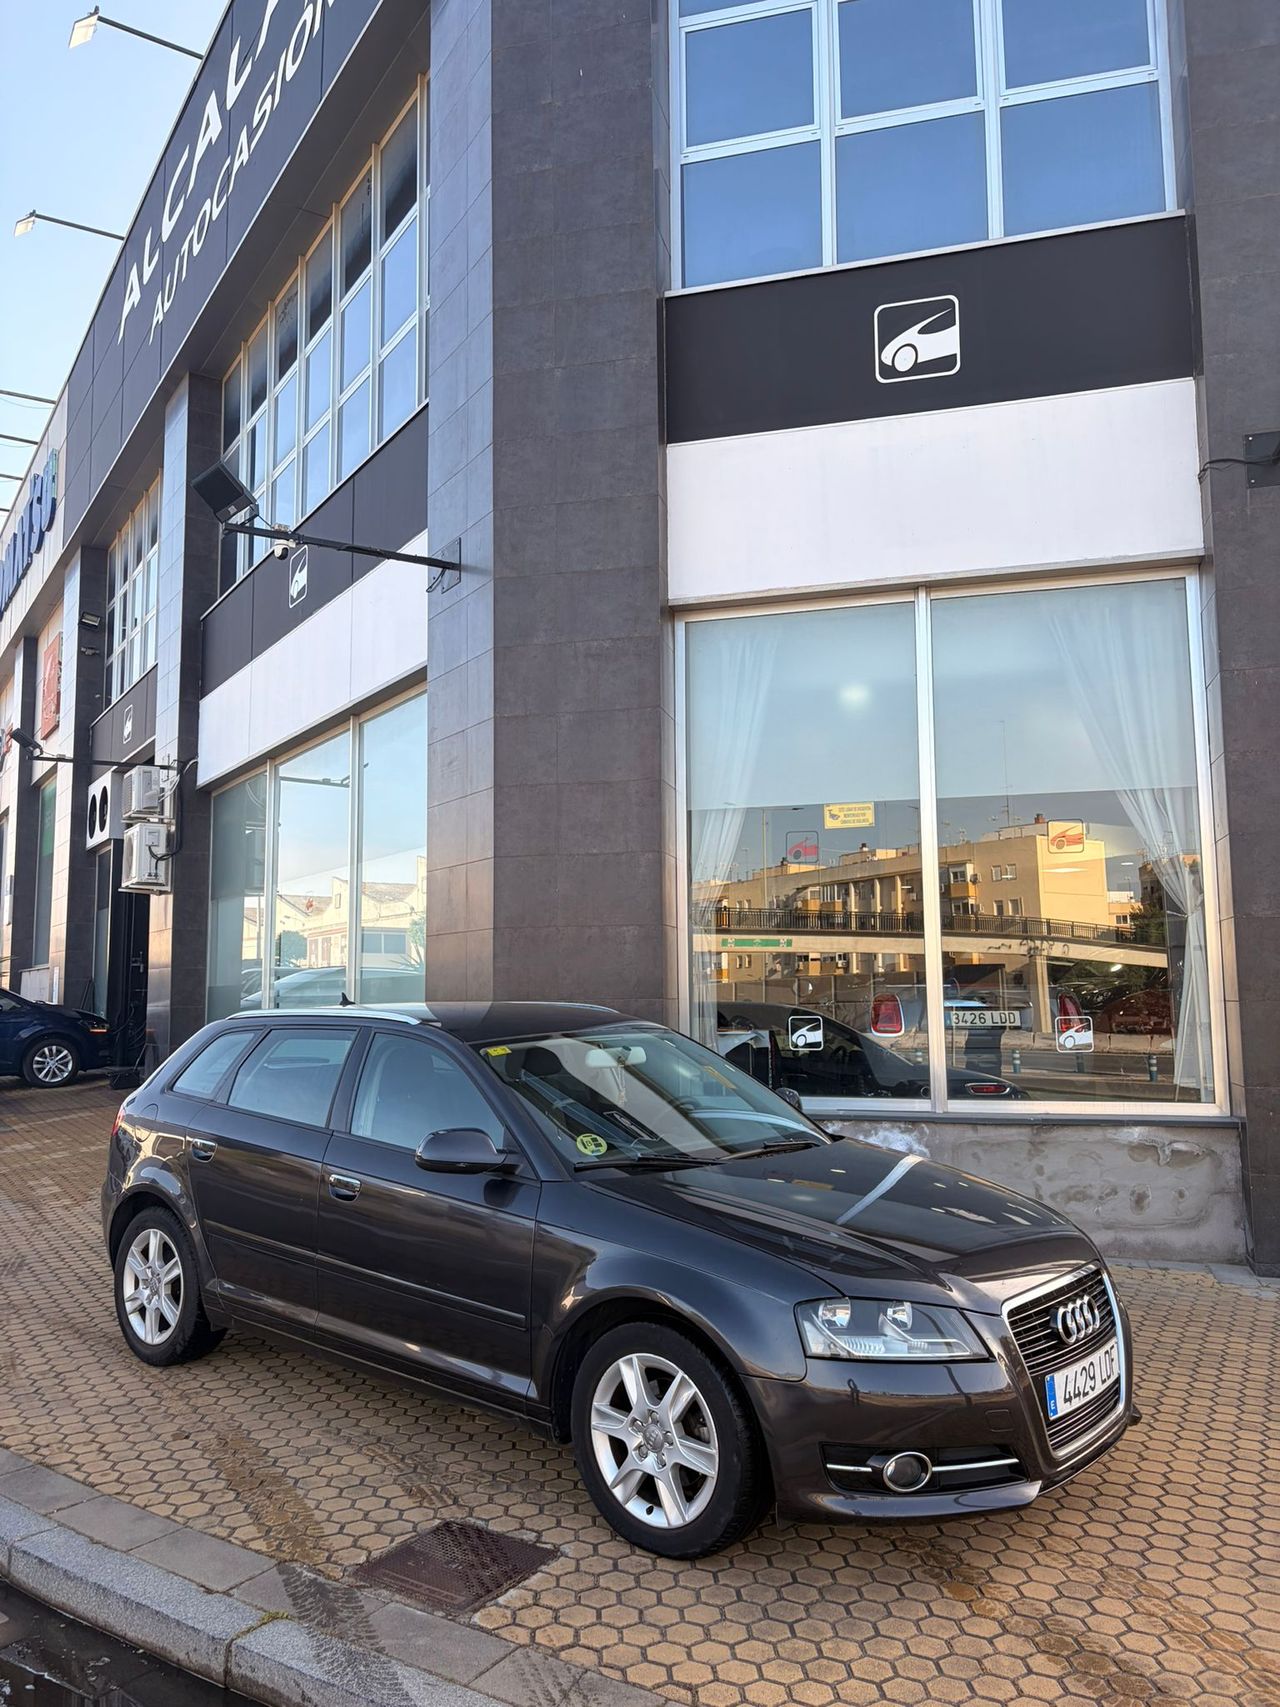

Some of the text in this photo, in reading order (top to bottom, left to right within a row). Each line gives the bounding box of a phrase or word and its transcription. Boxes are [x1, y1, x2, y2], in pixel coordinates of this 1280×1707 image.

[953, 1012, 1016, 1025] 3426 LDD
[1064, 1361, 1097, 1405] 4429
[1099, 1344, 1115, 1385] LDF
